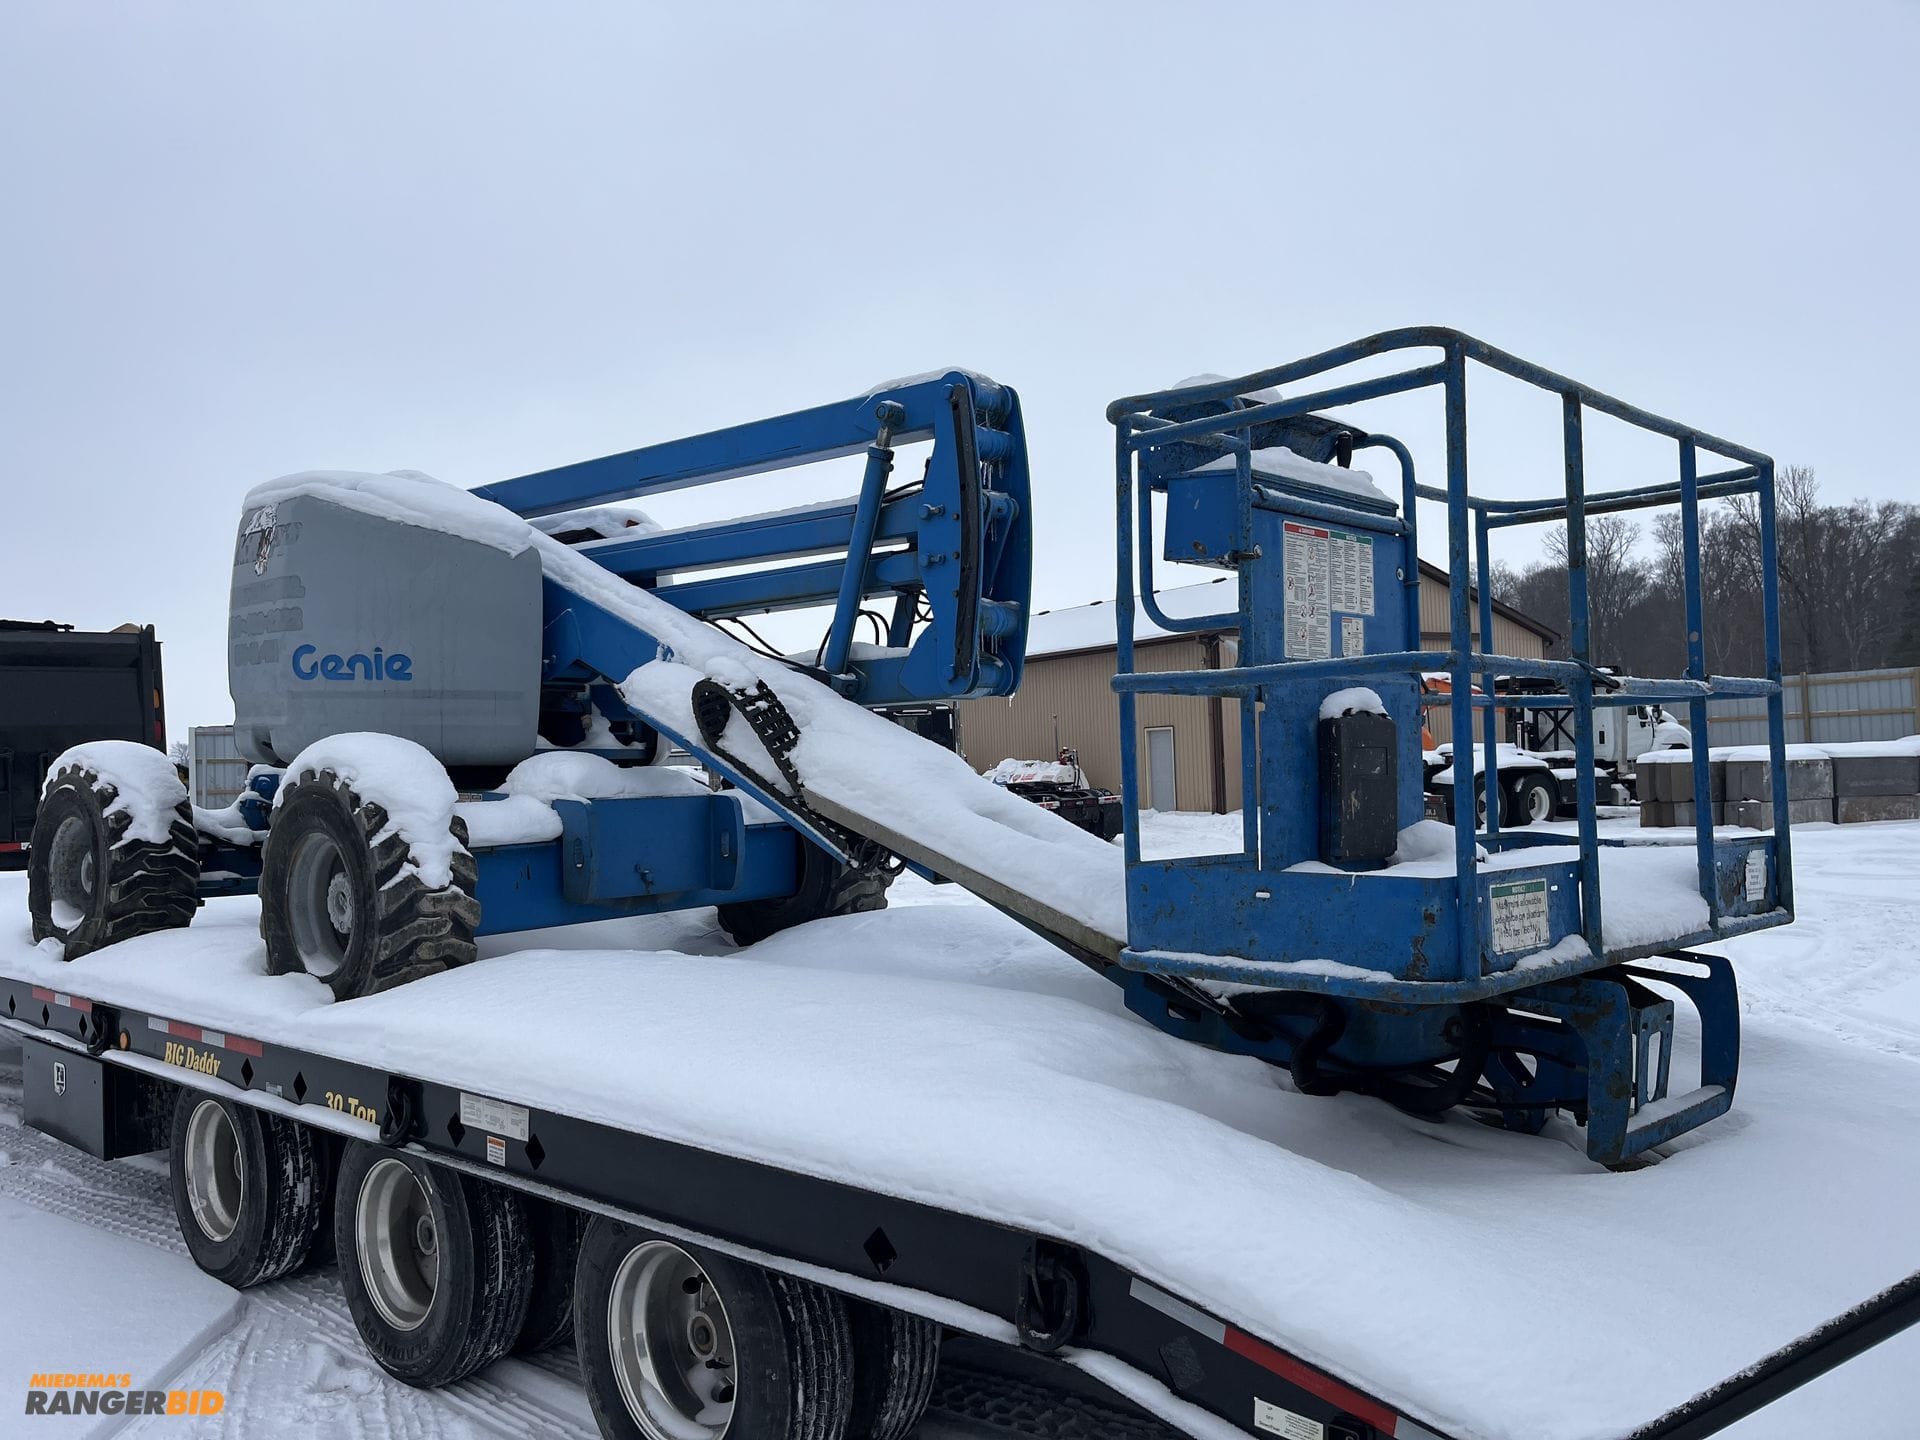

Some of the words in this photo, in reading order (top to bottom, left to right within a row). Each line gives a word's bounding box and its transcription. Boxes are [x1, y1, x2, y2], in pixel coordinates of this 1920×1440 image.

[292, 644, 412, 681] Genie
[164, 1041, 185, 1066] BIG
[185, 1046, 221, 1077] Daddy
[325, 1091, 344, 1112] 30
[348, 1097, 377, 1123] Ton
